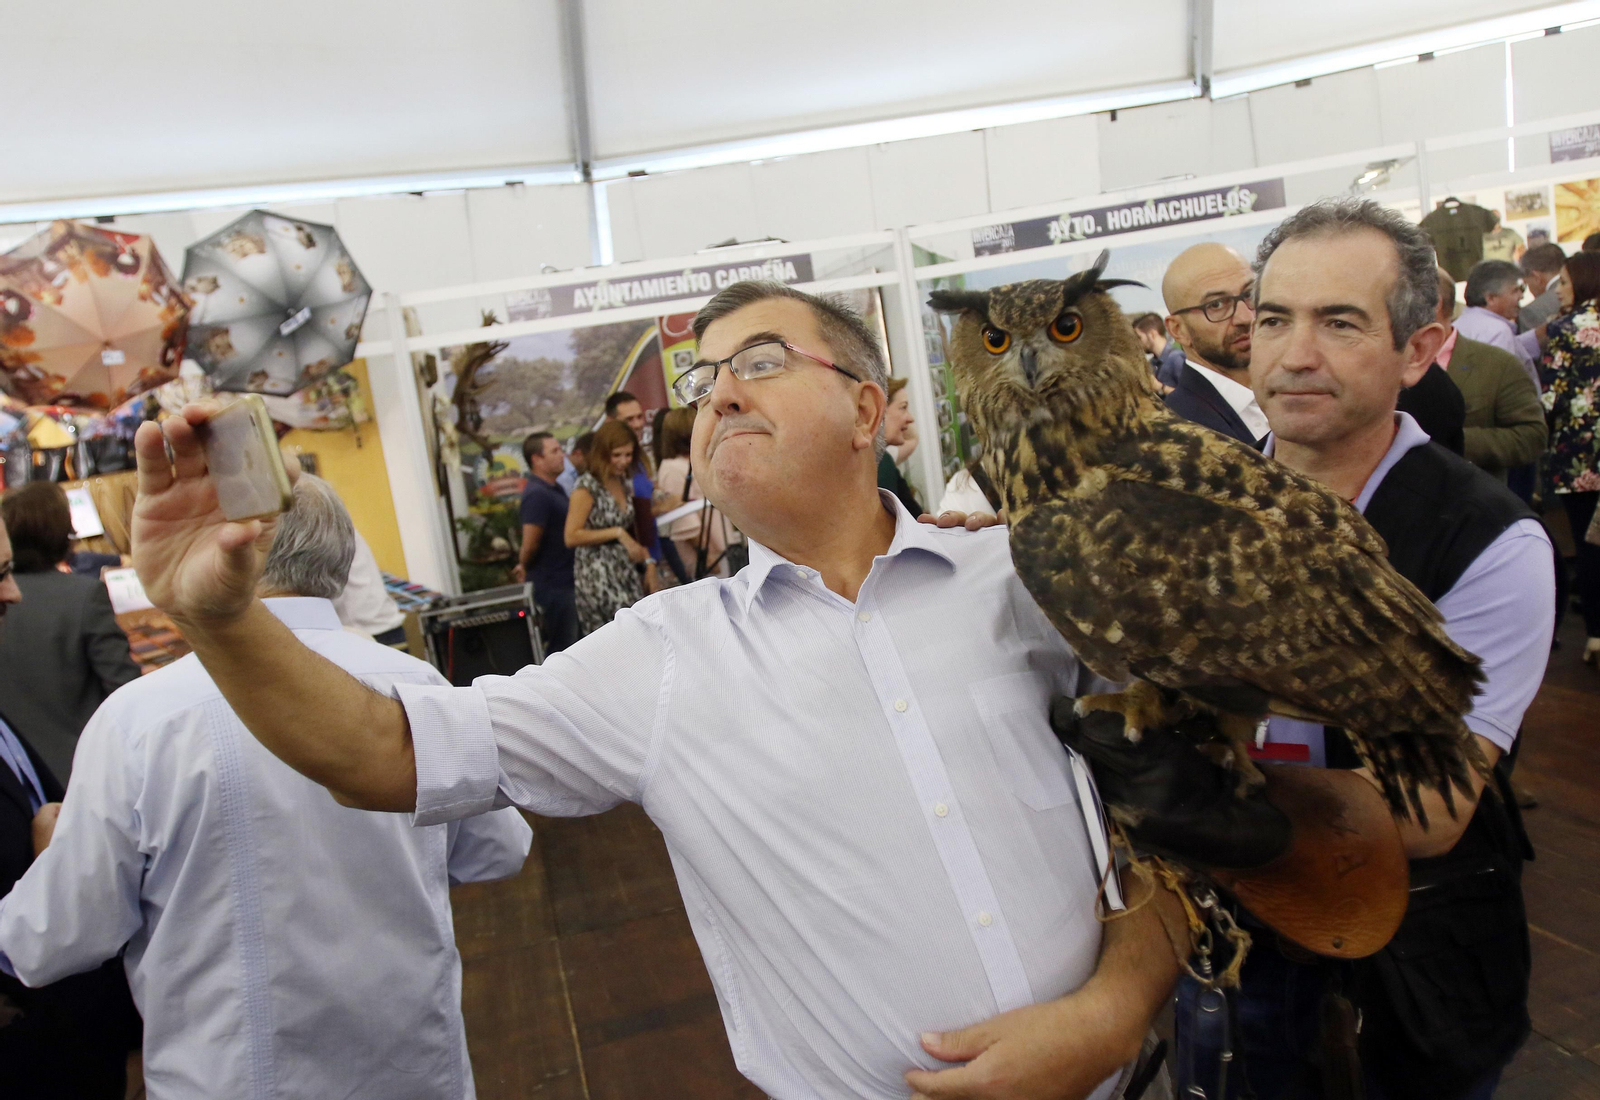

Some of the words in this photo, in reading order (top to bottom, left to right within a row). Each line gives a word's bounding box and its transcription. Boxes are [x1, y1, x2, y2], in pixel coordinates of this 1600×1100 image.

[1050, 214, 1102, 239] AYTO.
[1107, 188, 1252, 231] HORNACHUELOS
[574, 272, 712, 309] AYUNTAMIENTO
